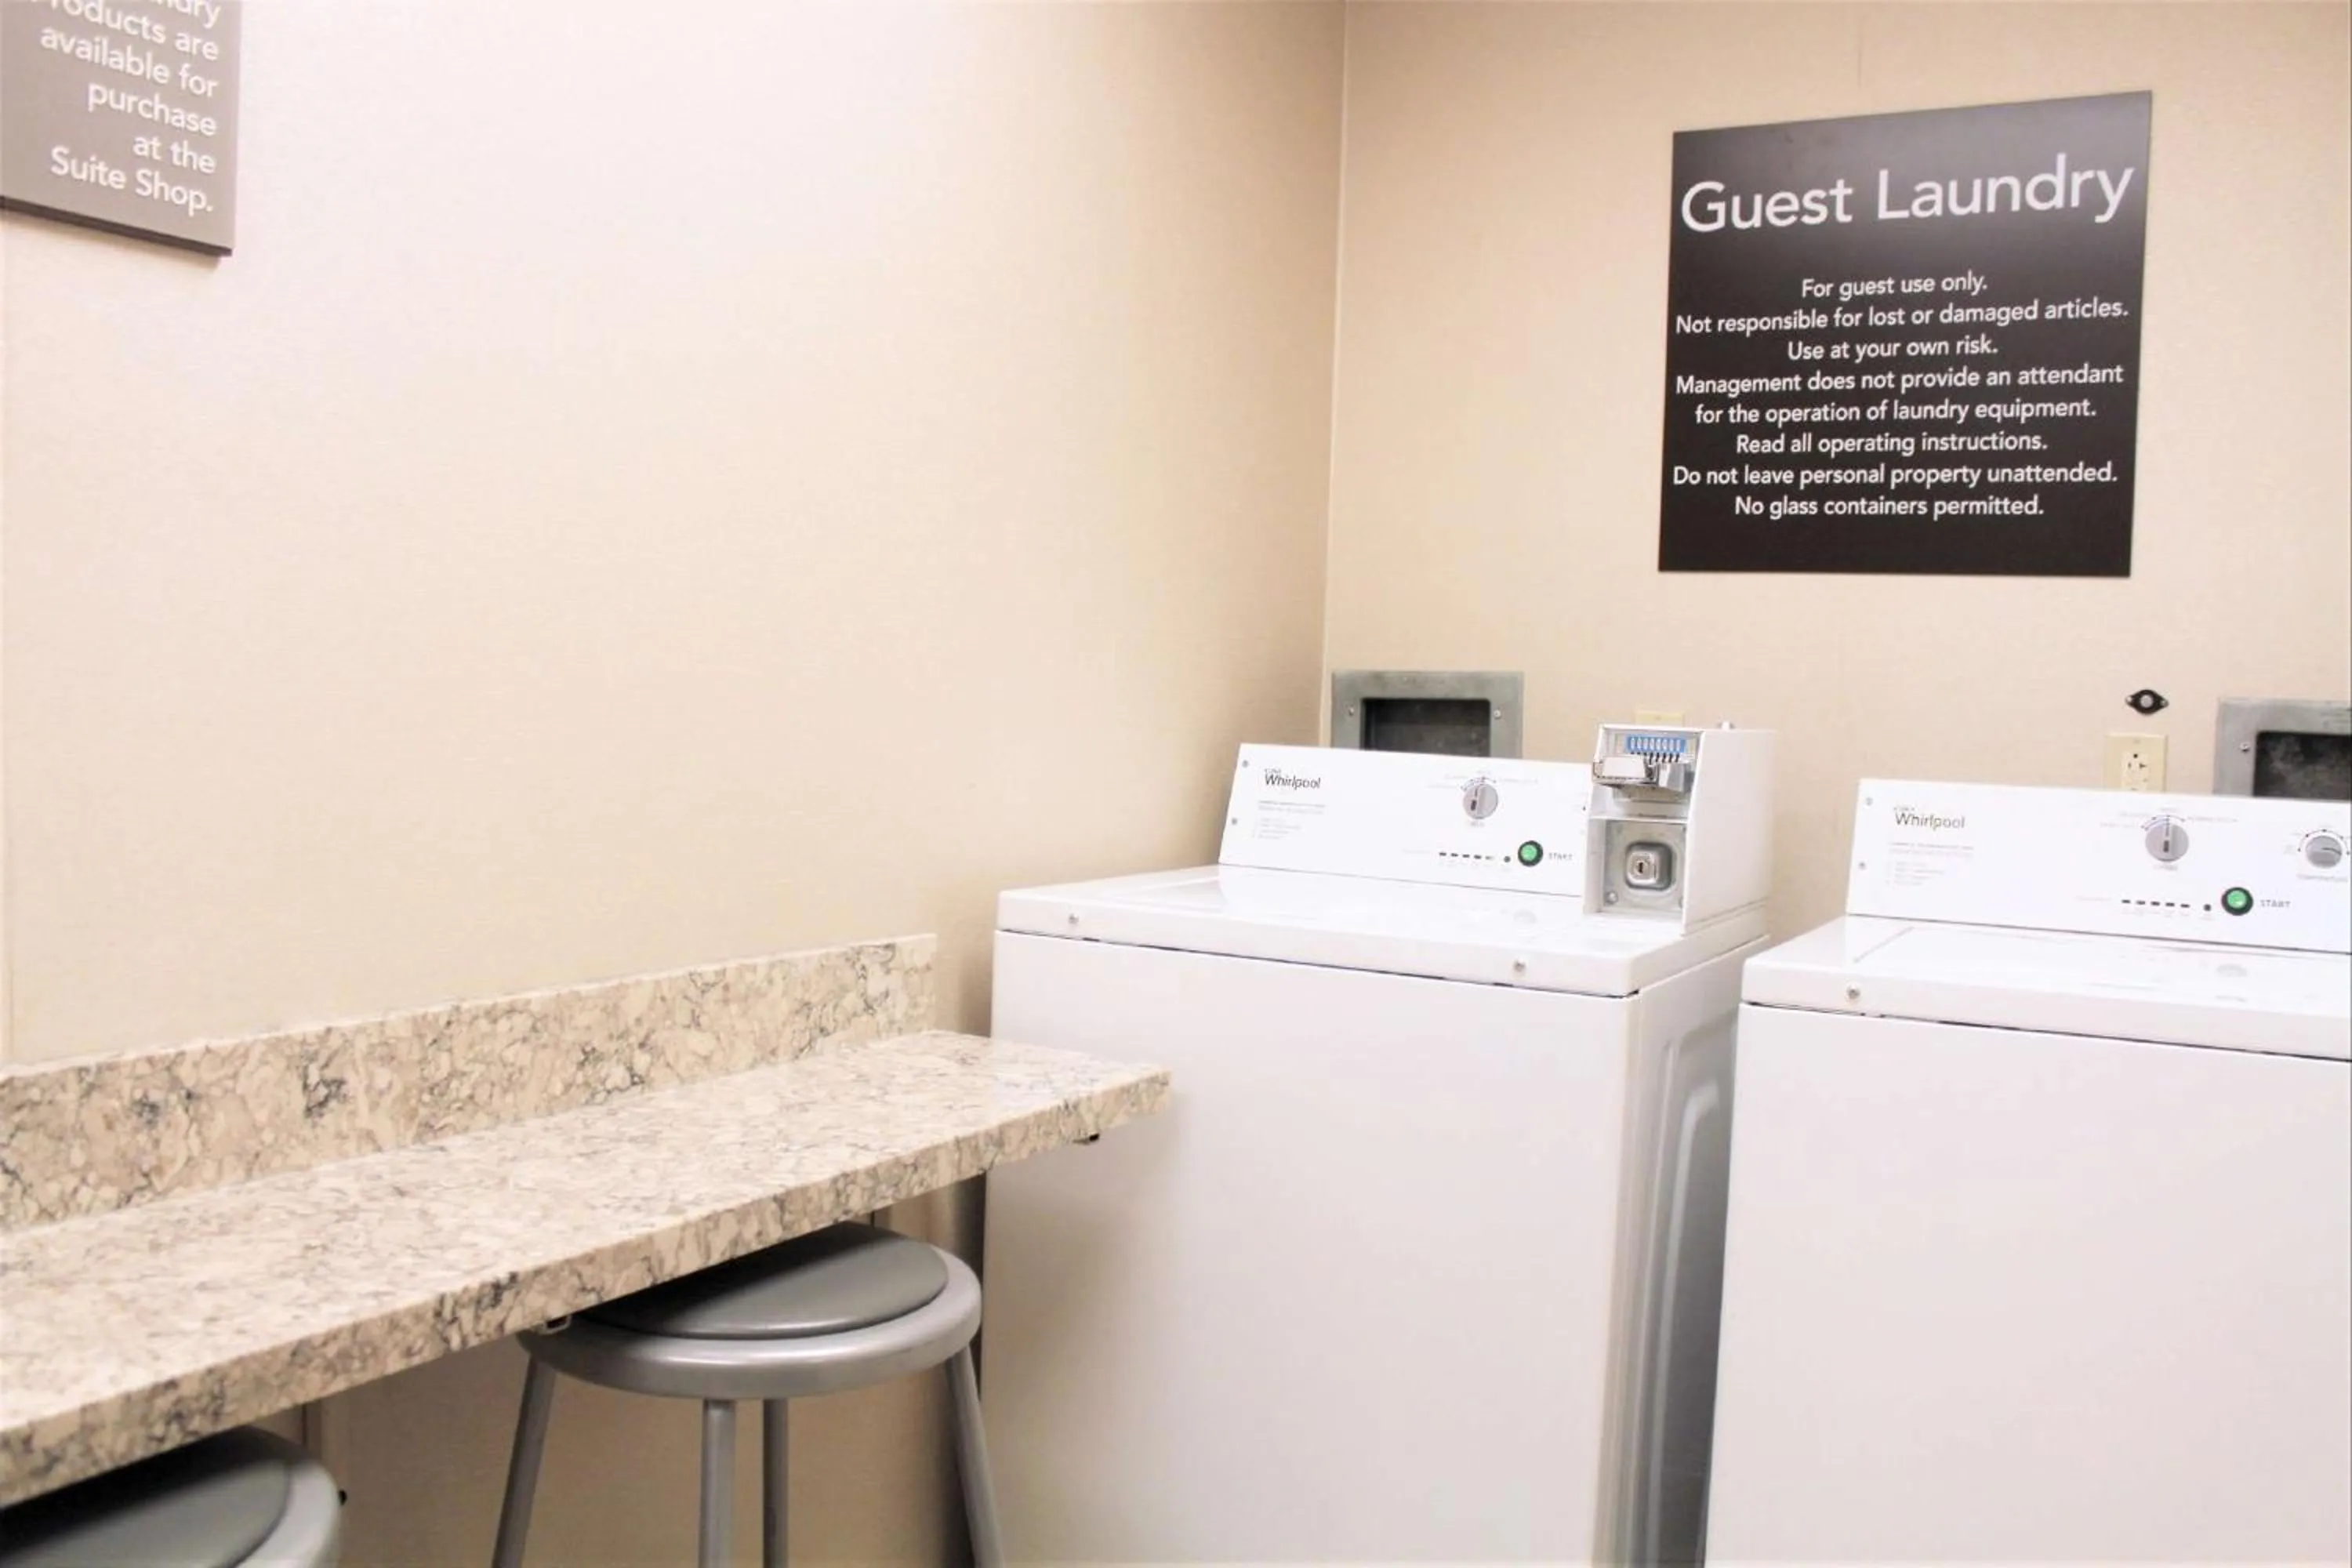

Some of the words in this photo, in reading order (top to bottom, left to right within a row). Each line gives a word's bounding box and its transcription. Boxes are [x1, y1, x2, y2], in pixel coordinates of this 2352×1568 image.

[175, 31, 219, 60] are
[41, 27, 170, 84] available
[179, 63, 218, 97] for
[88, 82, 217, 136] purchase
[132, 136, 162, 161] at
[170, 140, 216, 174] the
[51, 144, 126, 190] Suite
[136, 169, 213, 217] Shop.
[1682, 178, 1854, 231] Guest
[1878, 152, 2135, 223] Laundry
[1802, 279, 1834, 297] For
[1839, 278, 1894, 301] guest
[1901, 278, 1935, 292] use
[1941, 270, 1987, 296] only.
[1676, 315, 1711, 332] Not
[1718, 309, 1828, 337] responsible
[1834, 307, 1863, 326] for
[1869, 307, 1905, 325] lost
[1911, 310, 1933, 324] or
[1940, 299, 2038, 326] damaged
[2045, 296, 2128, 318] articles.
[1788, 341, 1824, 360] Use
[1831, 342, 1849, 358] at
[1855, 343, 1900, 363] your
[1907, 341, 1949, 355] own
[1957, 333, 1998, 354] risk.
[1677, 375, 1802, 397] Management
[1808, 371, 1855, 390] does
[1862, 372, 1895, 388] not
[1901, 366, 1980, 394] provide
[1987, 372, 2010, 386] an
[2018, 363, 2123, 384] attendant
[1696, 404, 1723, 423] for
[1728, 404, 1759, 423] the
[1766, 402, 1860, 428] operation
[1867, 399, 1888, 420] of
[1894, 398, 1969, 423] laundry
[1975, 398, 2096, 423] equipment.
[1737, 434, 1784, 453] Read
[1791, 433, 1811, 452] all
[1818, 433, 1915, 458] operating
[1922, 431, 2047, 450] instructions.
[1674, 466, 1700, 485] Do
[1707, 468, 1737, 484] not
[1745, 465, 1794, 484] leave
[1800, 463, 1884, 489] personal
[1891, 466, 1981, 489] property
[1987, 461, 2117, 482] unattended.
[1736, 496, 1764, 514] No
[1769, 495, 1817, 520] glass
[1824, 495, 1927, 514] containers
[1934, 494, 2043, 521] permitted.
[1265, 774, 1321, 790] Whirlpool
[1894, 812, 1965, 831] Whirlpool
